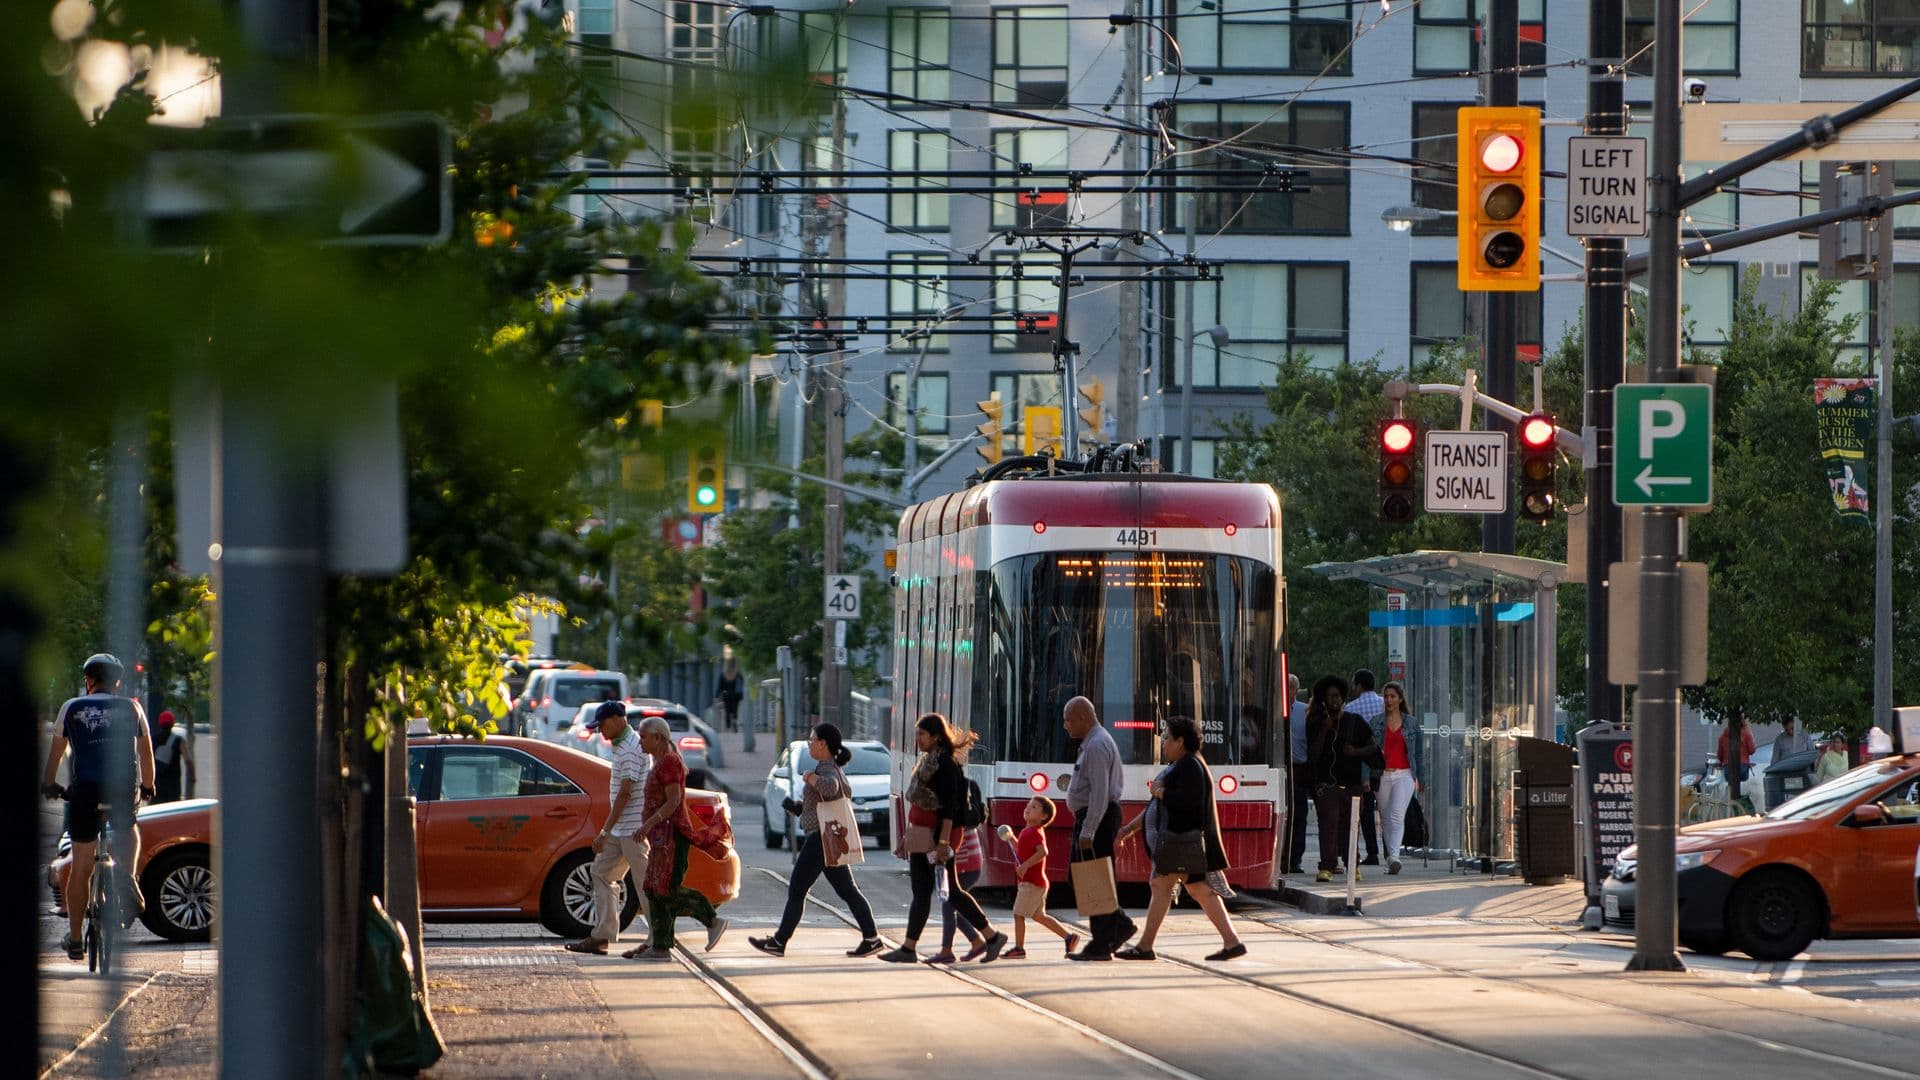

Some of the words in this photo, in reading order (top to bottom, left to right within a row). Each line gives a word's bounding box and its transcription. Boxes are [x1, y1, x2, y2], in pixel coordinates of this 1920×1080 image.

[1582, 149, 1633, 168] LEFT
[1579, 177, 1636, 196] TURN
[1573, 205, 1640, 224] SIGNAL
[1816, 407, 1869, 418] SUMMER
[1817, 417, 1856, 428] MUSIC
[1639, 399, 1686, 459] P
[1831, 427, 1856, 438] THE
[1819, 438, 1865, 449] GARDEN
[1432, 444, 1501, 467] TRANSIT
[1435, 476, 1496, 500] SIGNAL
[1116, 529, 1157, 545] 4491
[828, 593, 857, 612] 40
[1199, 720, 1224, 731] PASS
[1599, 772, 1633, 783] PUB
[1593, 783, 1634, 794] PARK
[1543, 791, 1568, 802] Litter
[1597, 801, 1617, 809] BLUE
[1598, 811, 1627, 819] ROGERS
[1600, 823, 1634, 831] HARBOUR
